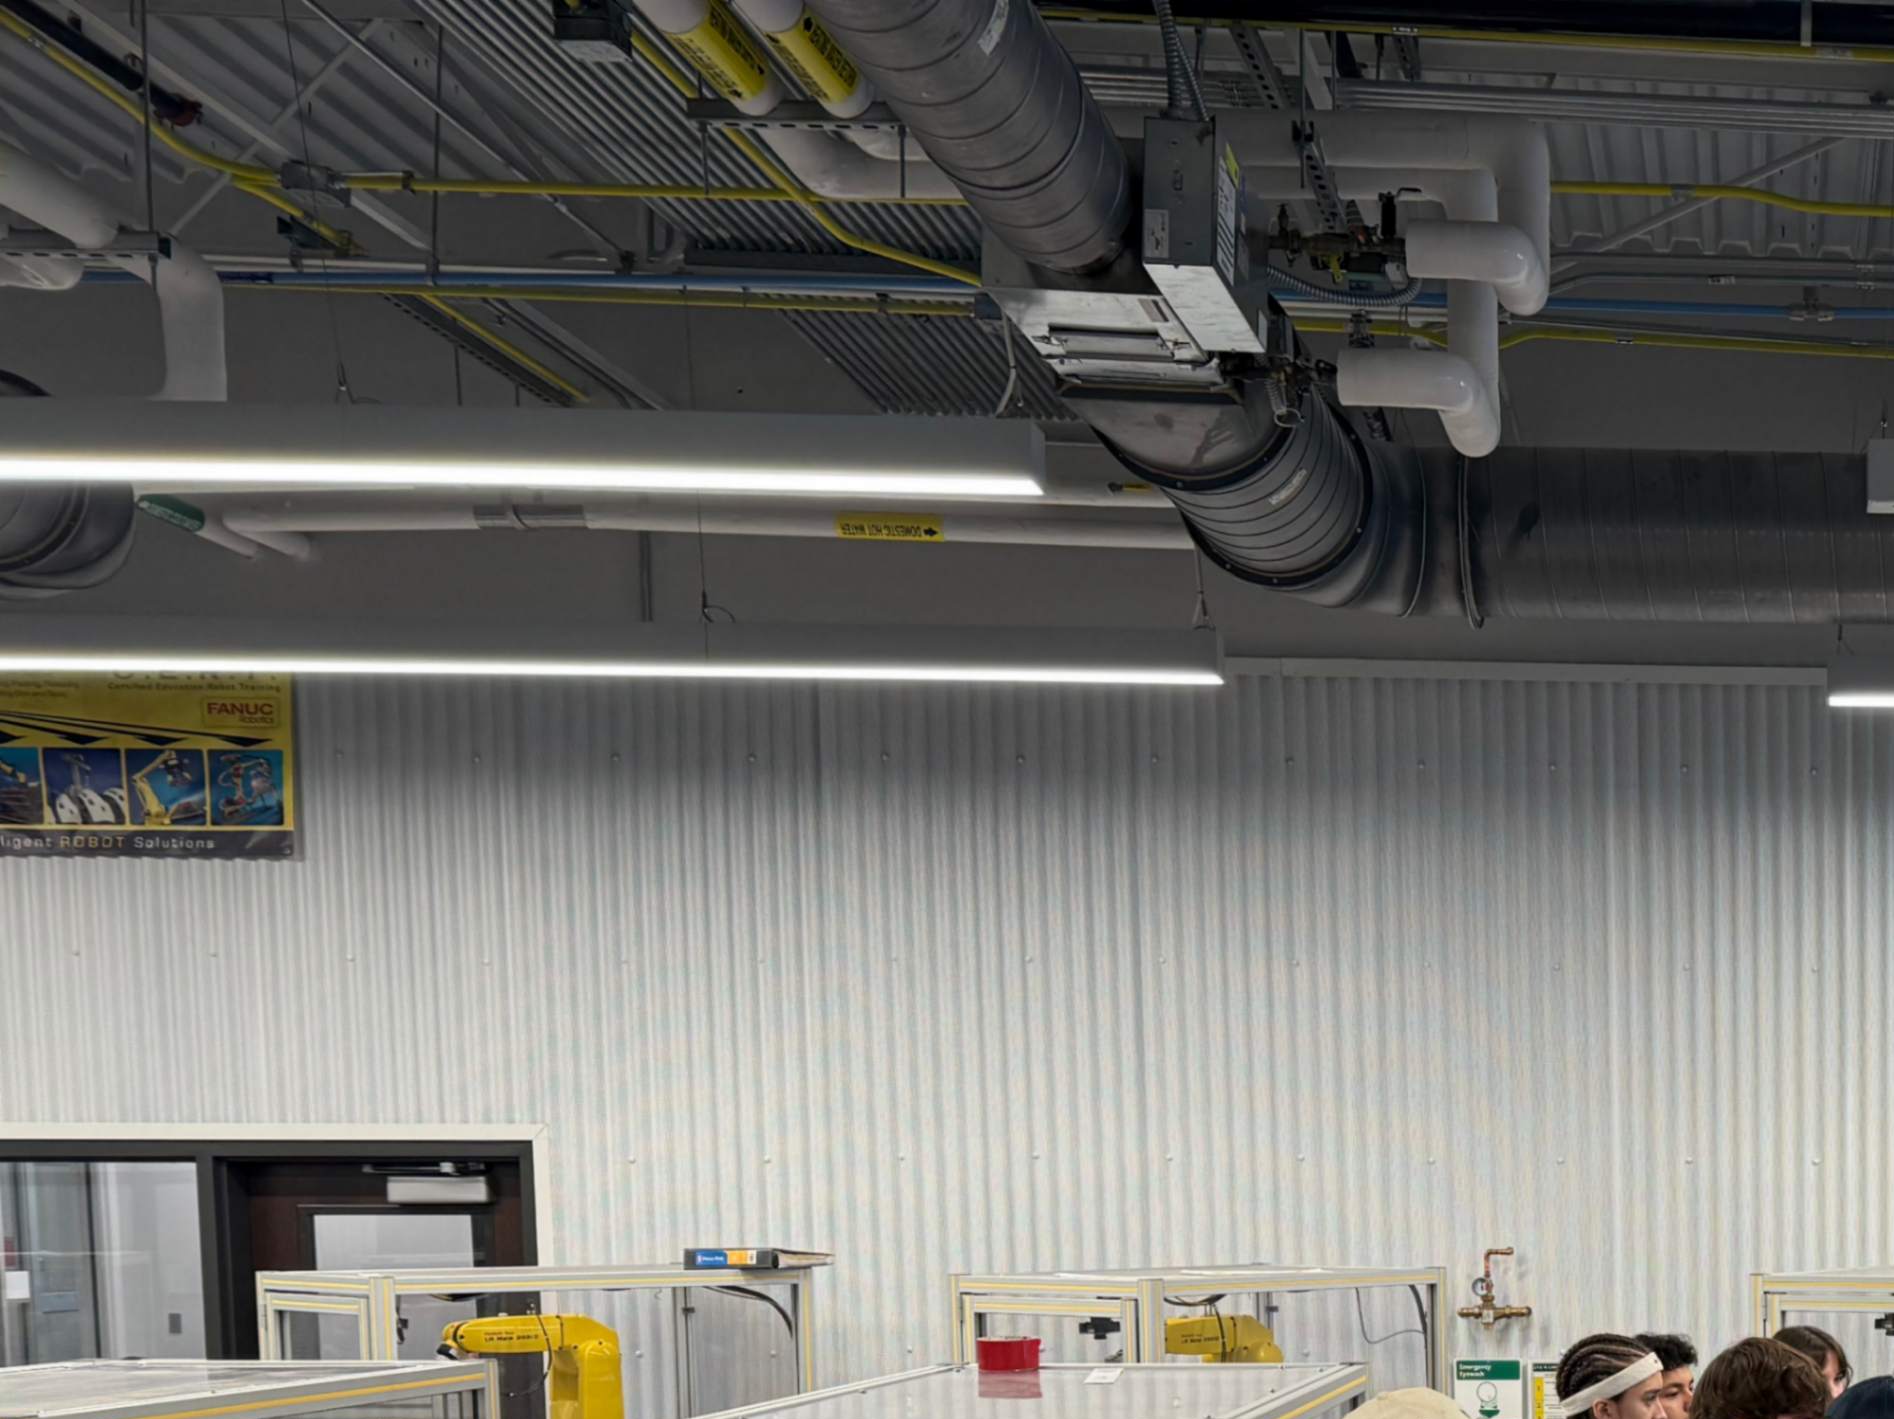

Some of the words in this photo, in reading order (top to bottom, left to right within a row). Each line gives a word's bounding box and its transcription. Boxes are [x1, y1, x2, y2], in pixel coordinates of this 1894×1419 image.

[842, 525, 865, 535] WATER
[867, 524, 883, 536] HOT
[884, 524, 922, 537] DOMESTIC
[206, 702, 274, 716] FANUC
[60, 836, 125, 848] ROBOT
[134, 836, 216, 848] Solutions
[1459, 1364, 1492, 1372] Emergency
